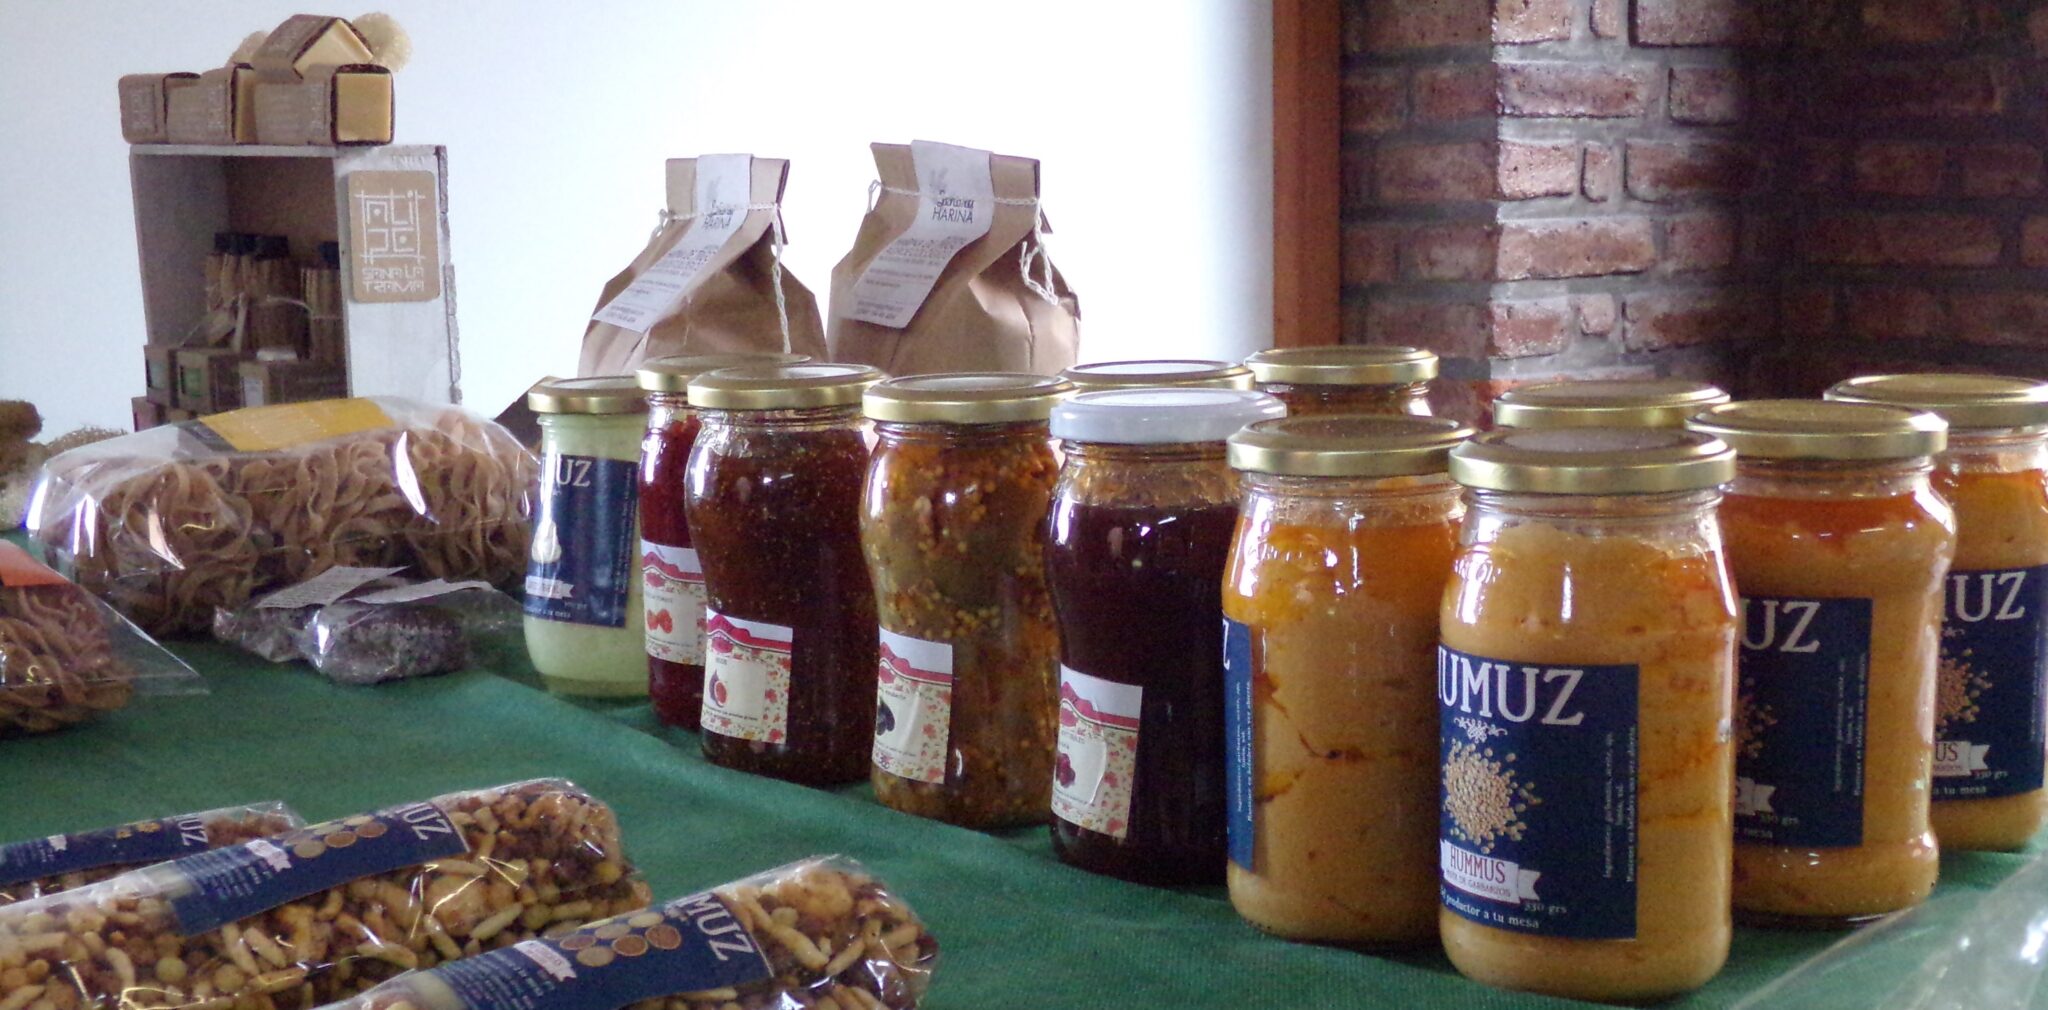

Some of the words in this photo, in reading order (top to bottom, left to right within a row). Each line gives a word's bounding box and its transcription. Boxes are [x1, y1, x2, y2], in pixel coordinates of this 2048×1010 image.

[932, 206, 974, 224] HARINA
[1449, 845, 1506, 884] HUMMUS
[1483, 911, 1490, 919] a
[1493, 912, 1504, 923] tu
[1508, 916, 1539, 929] mesa
